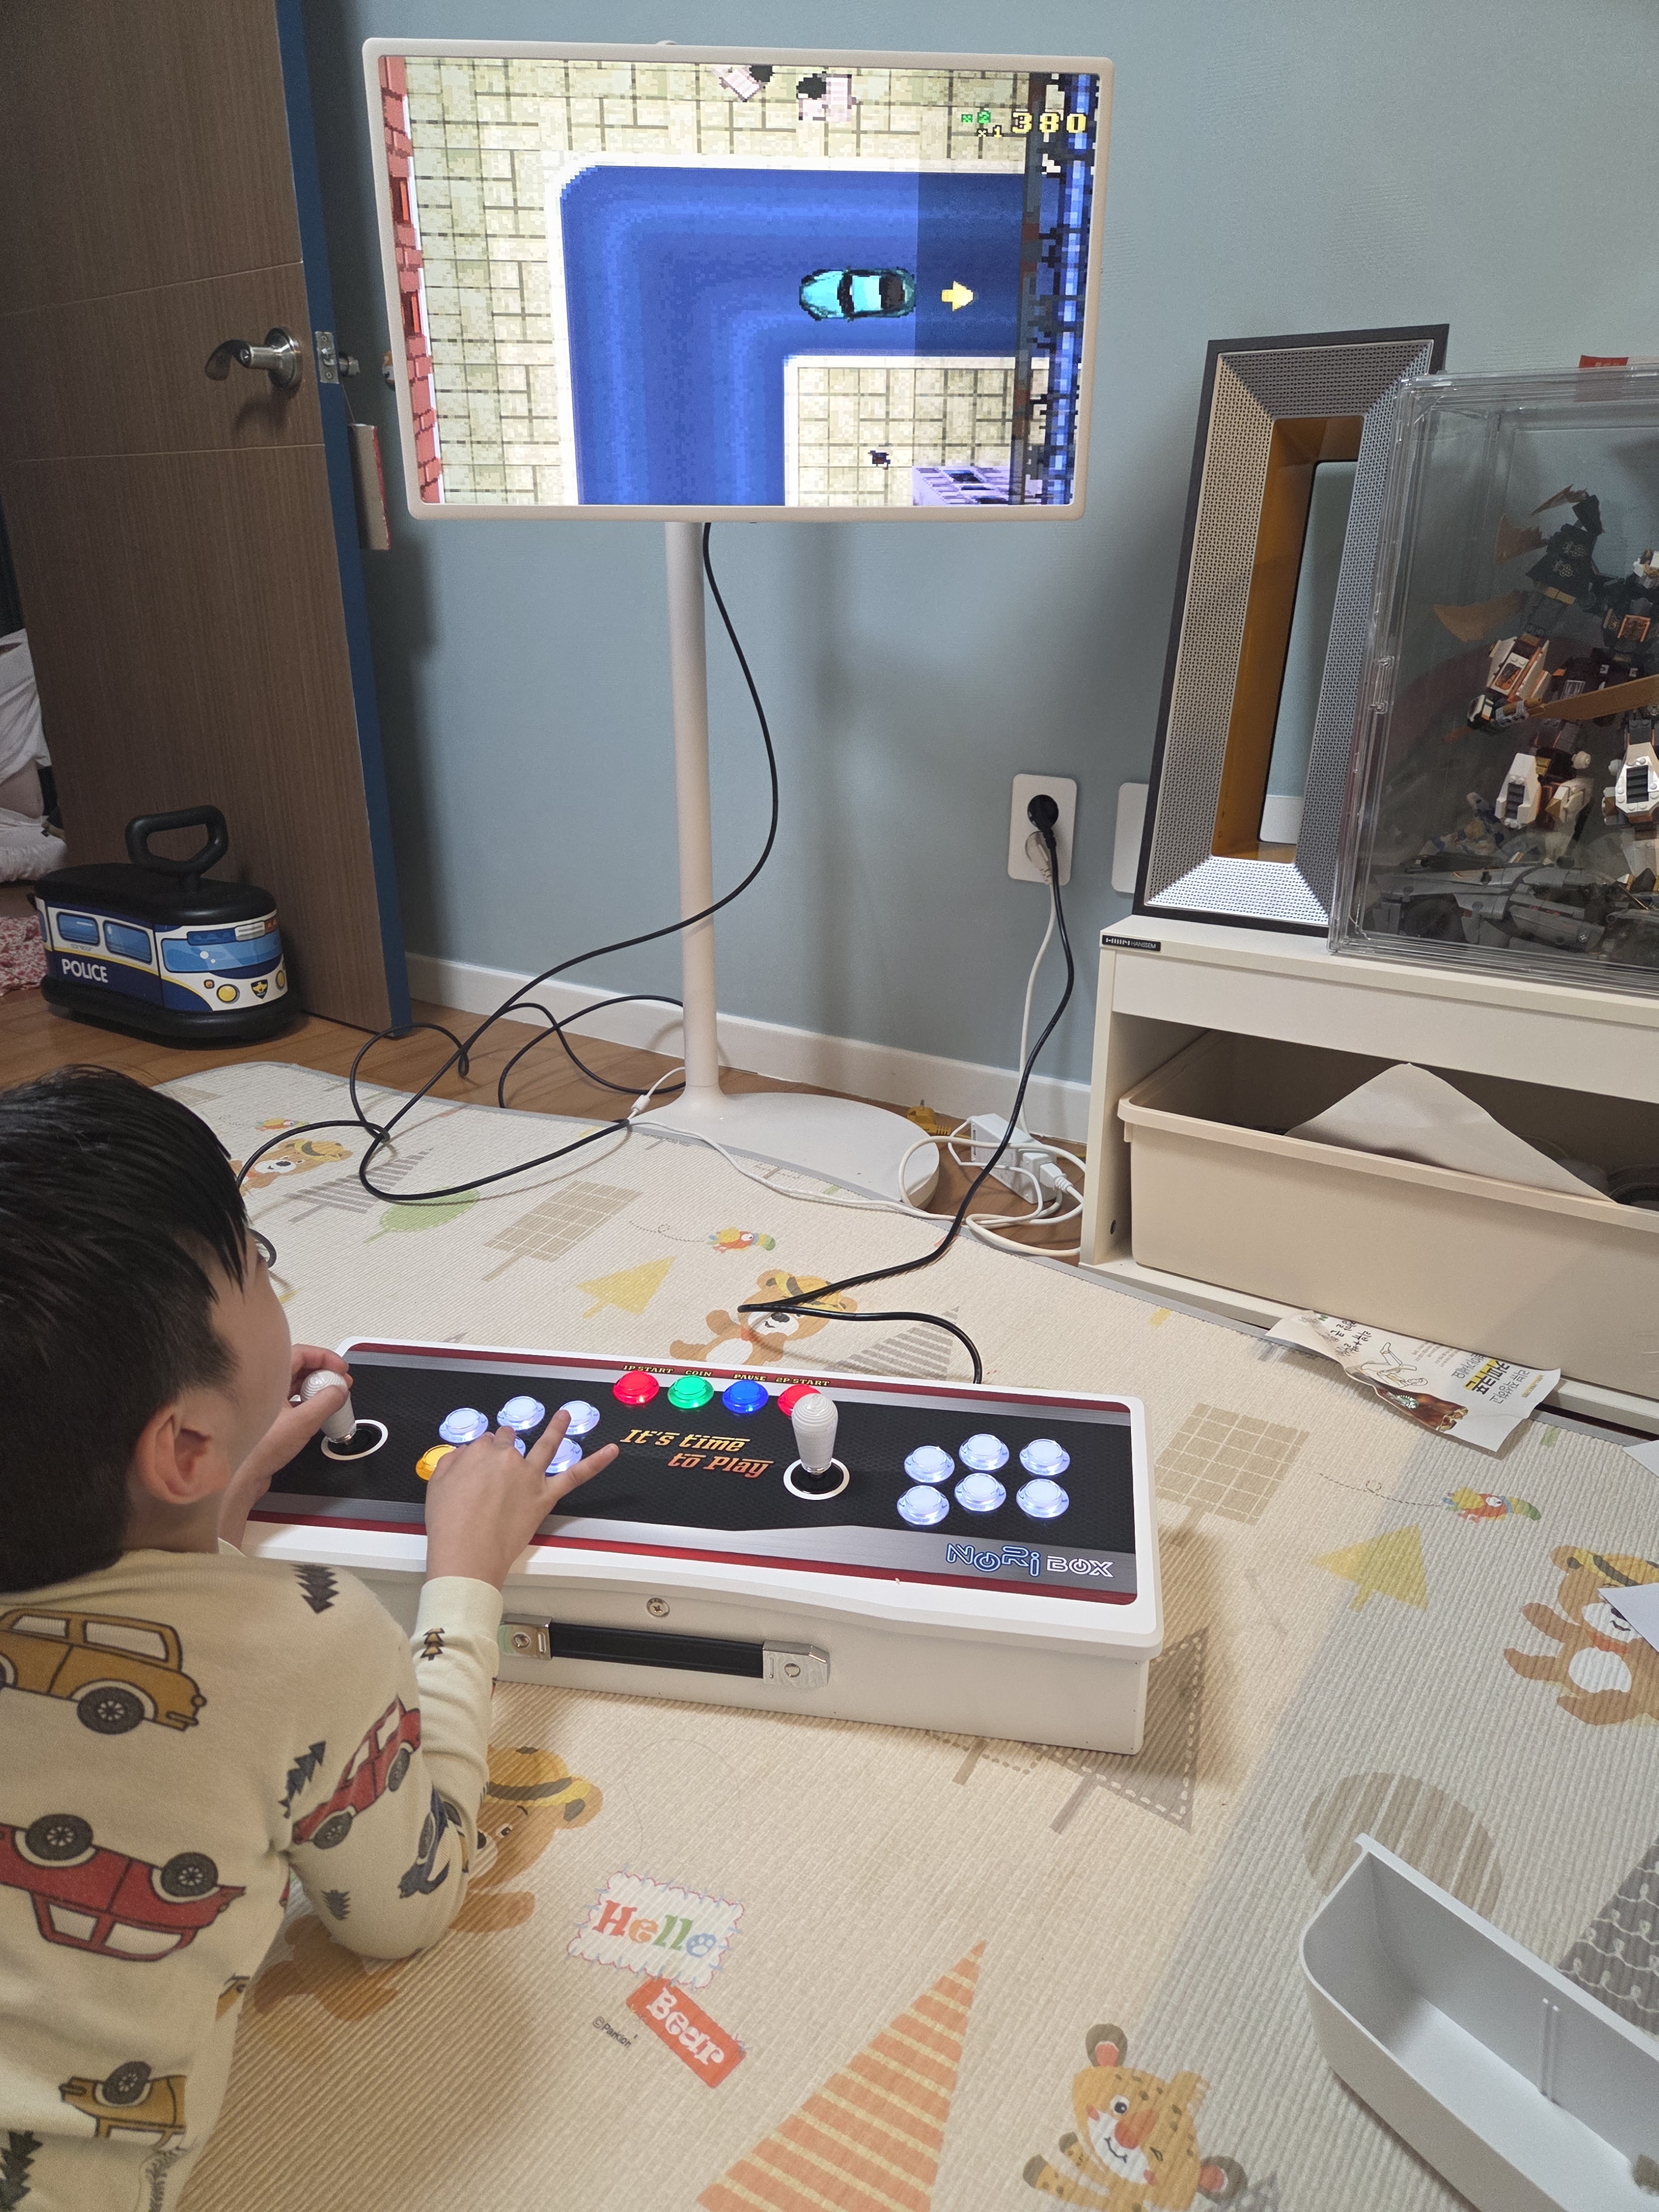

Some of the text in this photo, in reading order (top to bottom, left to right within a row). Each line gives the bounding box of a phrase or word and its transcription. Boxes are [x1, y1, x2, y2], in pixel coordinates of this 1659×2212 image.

[1012, 112, 1087, 133] 380
[1131, 941, 1156, 949] HANSSEM
[61, 958, 108, 983] POLICE
[638, 1366, 674, 1374] START
[733, 1373, 766, 1382] PAUSE
[792, 1378, 830, 1387] START
[1465, 1360, 1510, 1395] 커피쿠폰
[1490, 1369, 1530, 1404] 리뷰 작성하고
[619, 1428, 751, 1453] It's time
[667, 1452, 775, 1479] to Play
[1046, 1554, 1116, 1578] BOX
[592, 1900, 717, 1958] Hello
[646, 1987, 725, 2065] Bear
